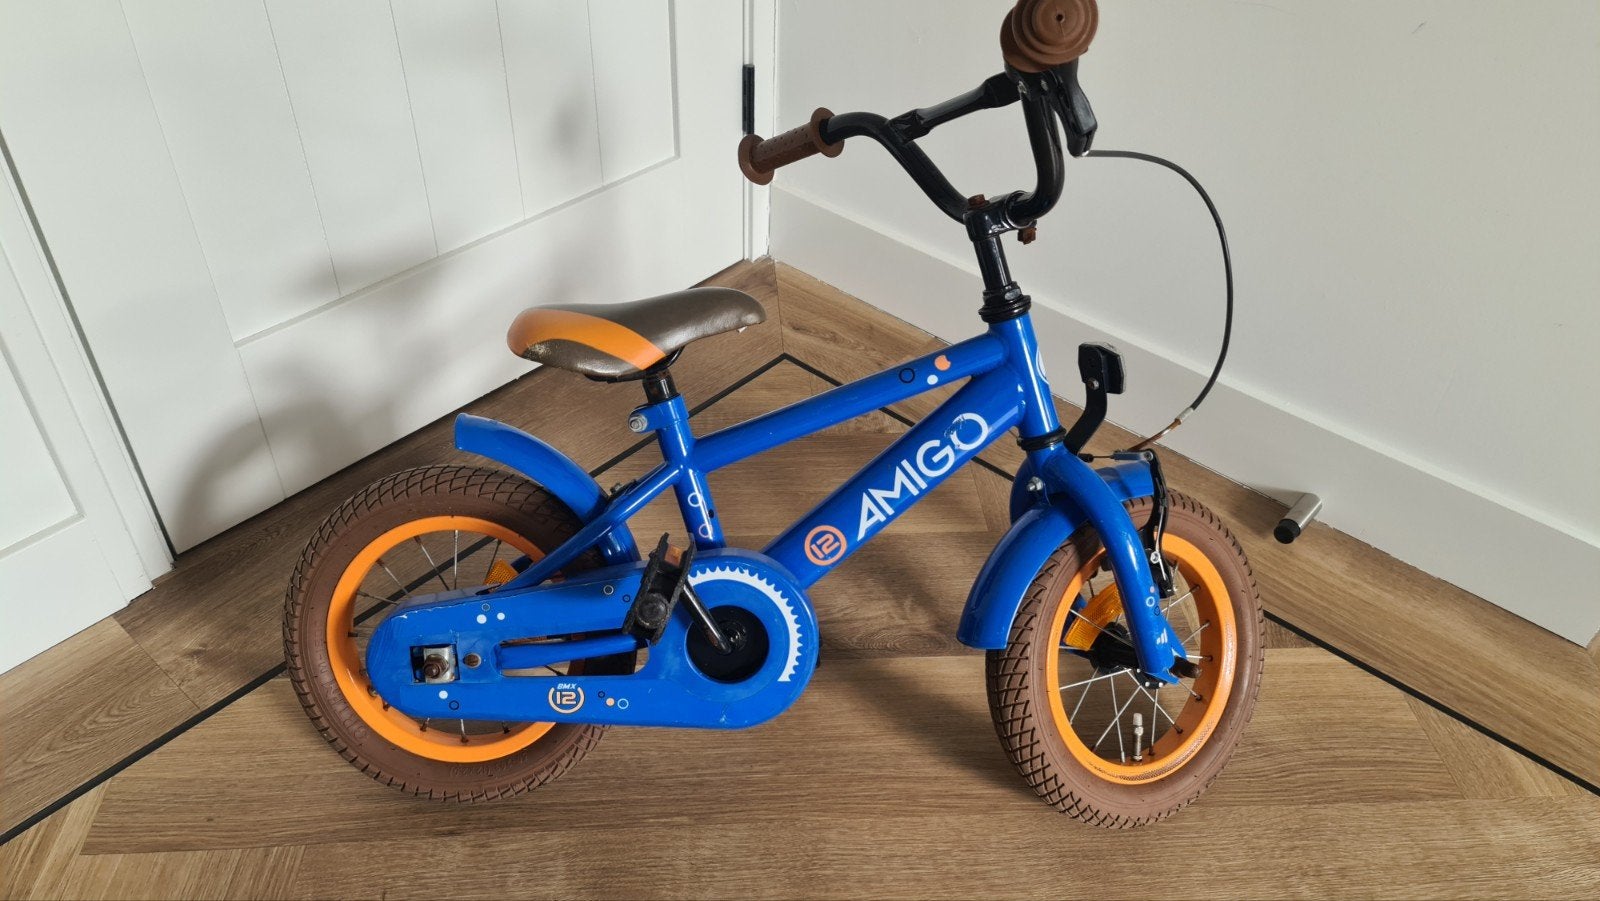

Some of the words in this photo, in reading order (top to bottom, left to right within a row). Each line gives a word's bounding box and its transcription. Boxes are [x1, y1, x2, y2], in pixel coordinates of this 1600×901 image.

[857, 412, 989, 541] AMIGO
[810, 533, 840, 559] 12
[556, 691, 577, 705] 12
